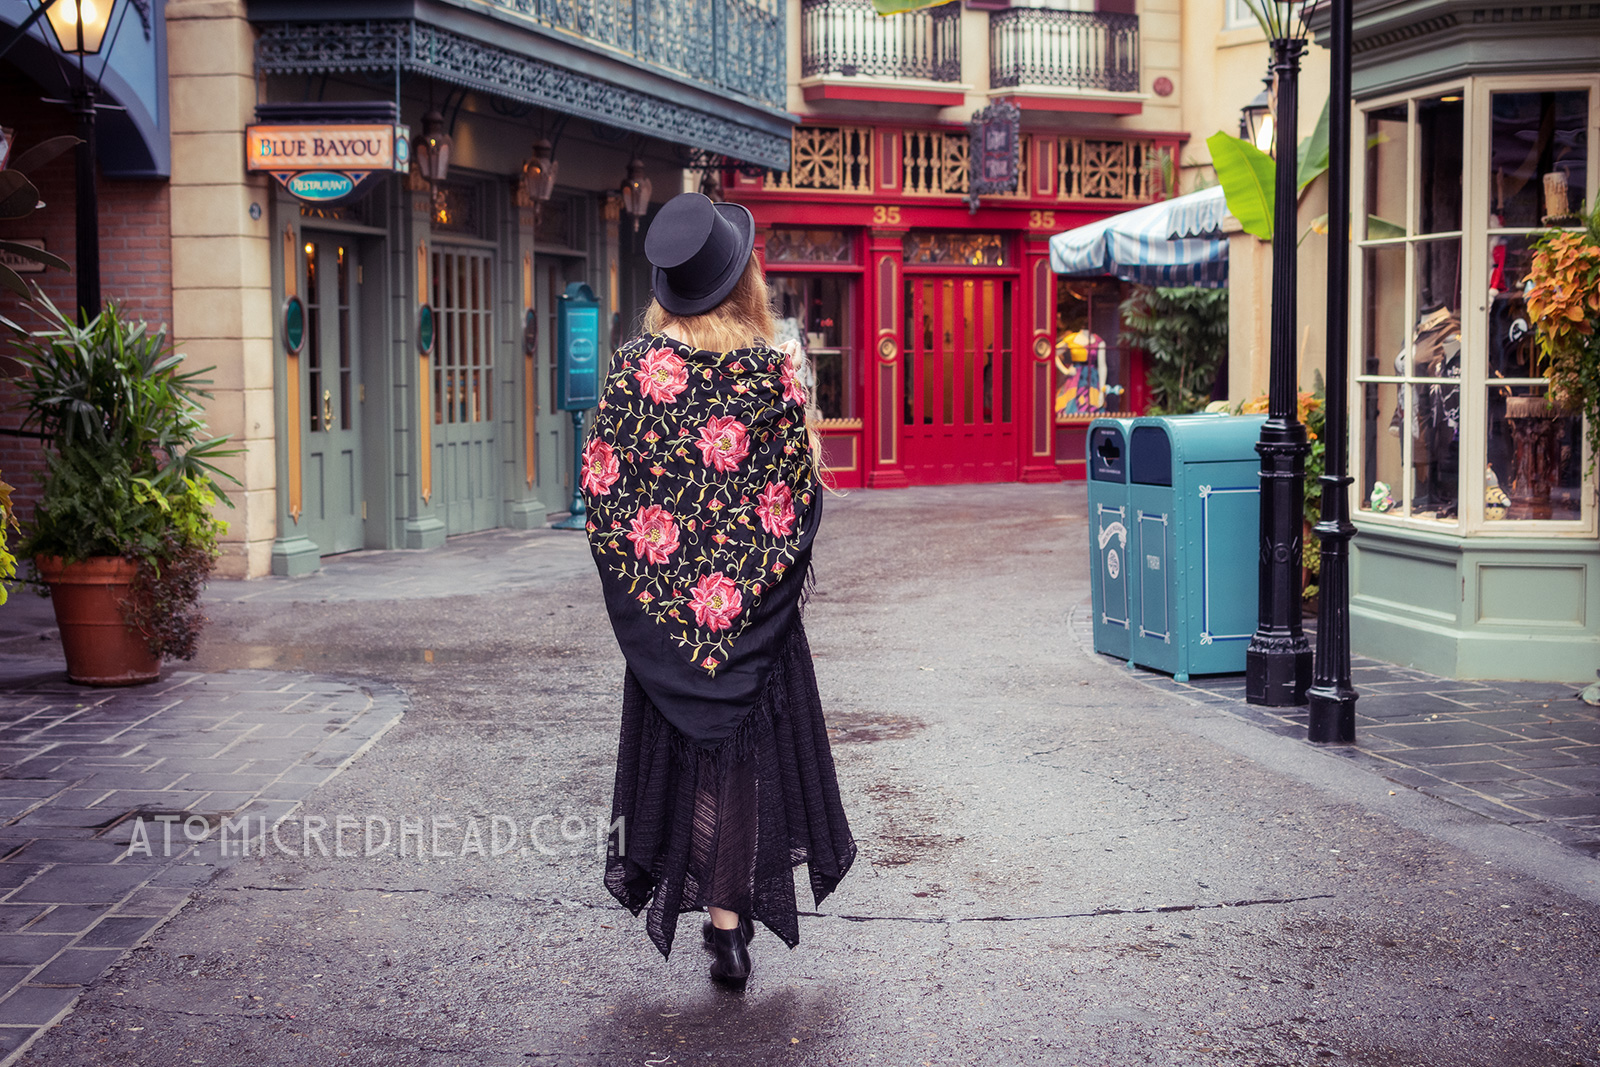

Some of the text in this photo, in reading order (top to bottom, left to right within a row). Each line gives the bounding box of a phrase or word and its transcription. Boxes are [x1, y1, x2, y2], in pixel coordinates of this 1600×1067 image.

[260, 138, 307, 157] BLUE
[313, 138, 382, 157] BAYOU
[293, 179, 348, 192] RESTAURANT
[873, 206, 901, 224] 35
[1028, 210, 1056, 228] 35
